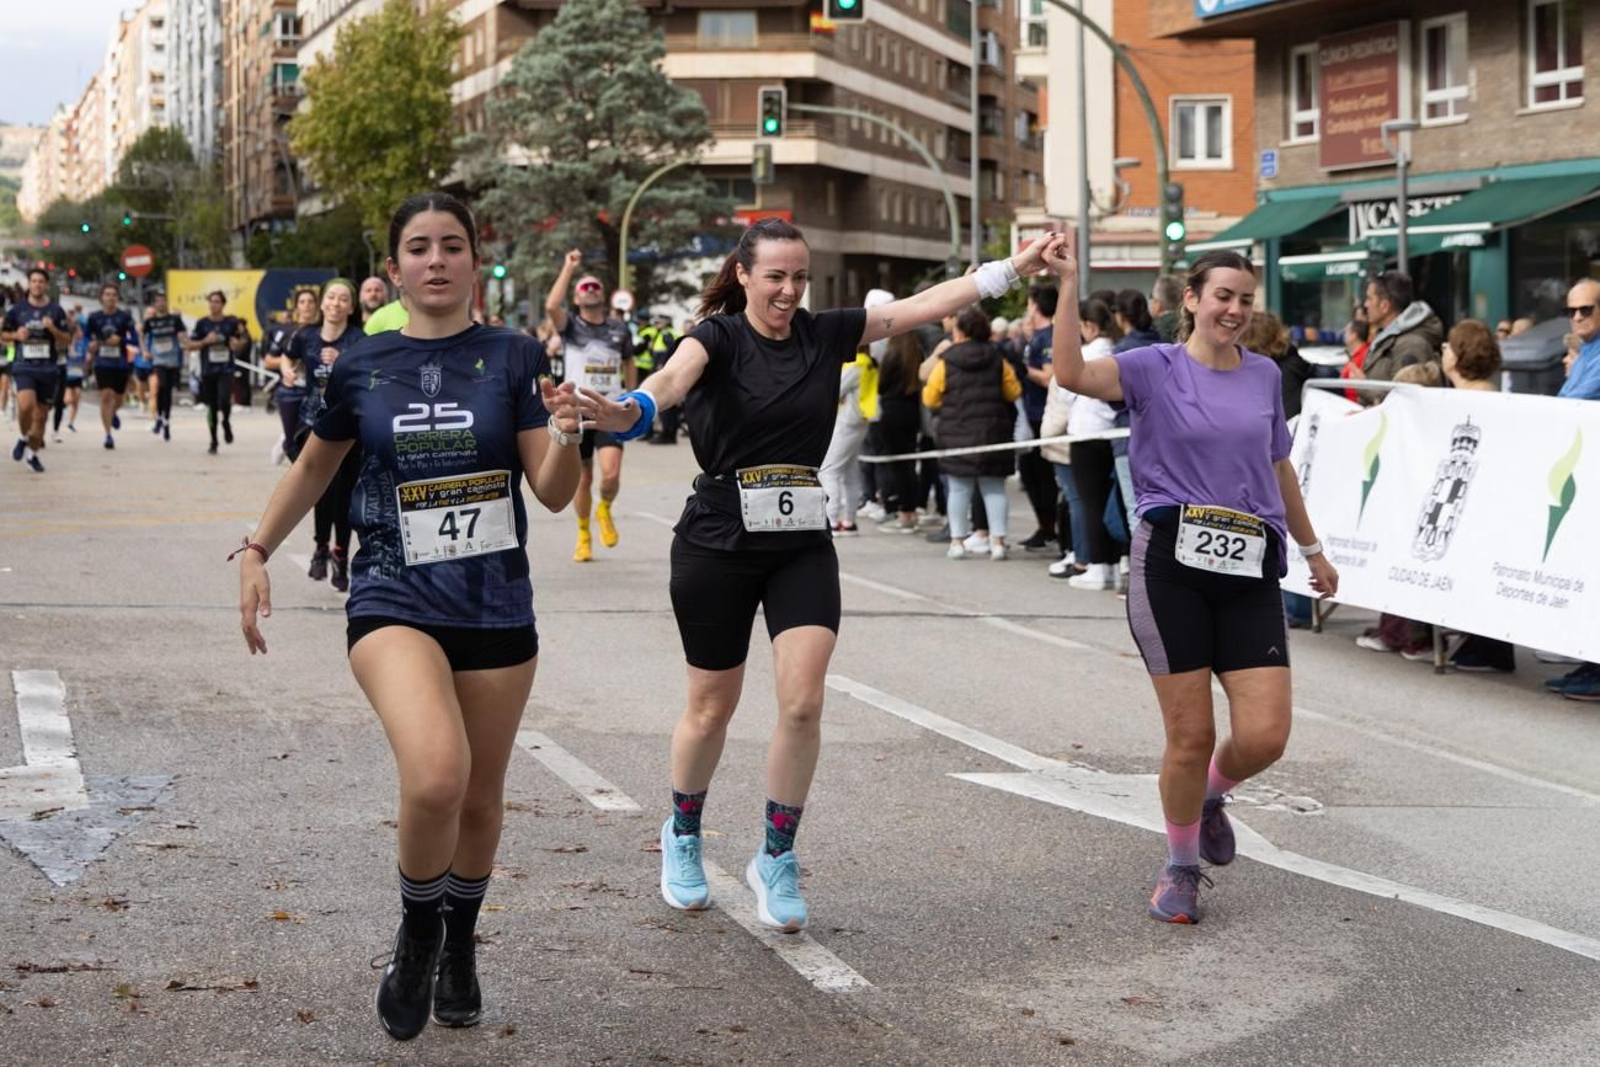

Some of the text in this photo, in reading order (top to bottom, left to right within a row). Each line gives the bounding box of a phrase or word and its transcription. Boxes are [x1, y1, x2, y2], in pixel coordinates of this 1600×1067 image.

[392, 402, 474, 433] 25
[393, 429, 475, 443] CARRERA
[395, 440, 477, 454] POPULAR
[402, 474, 506, 502] XXV CARRERA POPULAR
[440, 488, 462, 497] gran
[467, 481, 506, 493] caminata
[779, 491, 794, 516] 6
[1185, 507, 1205, 519] XXV
[438, 507, 481, 541] 47
[1194, 530, 1246, 561] 232
